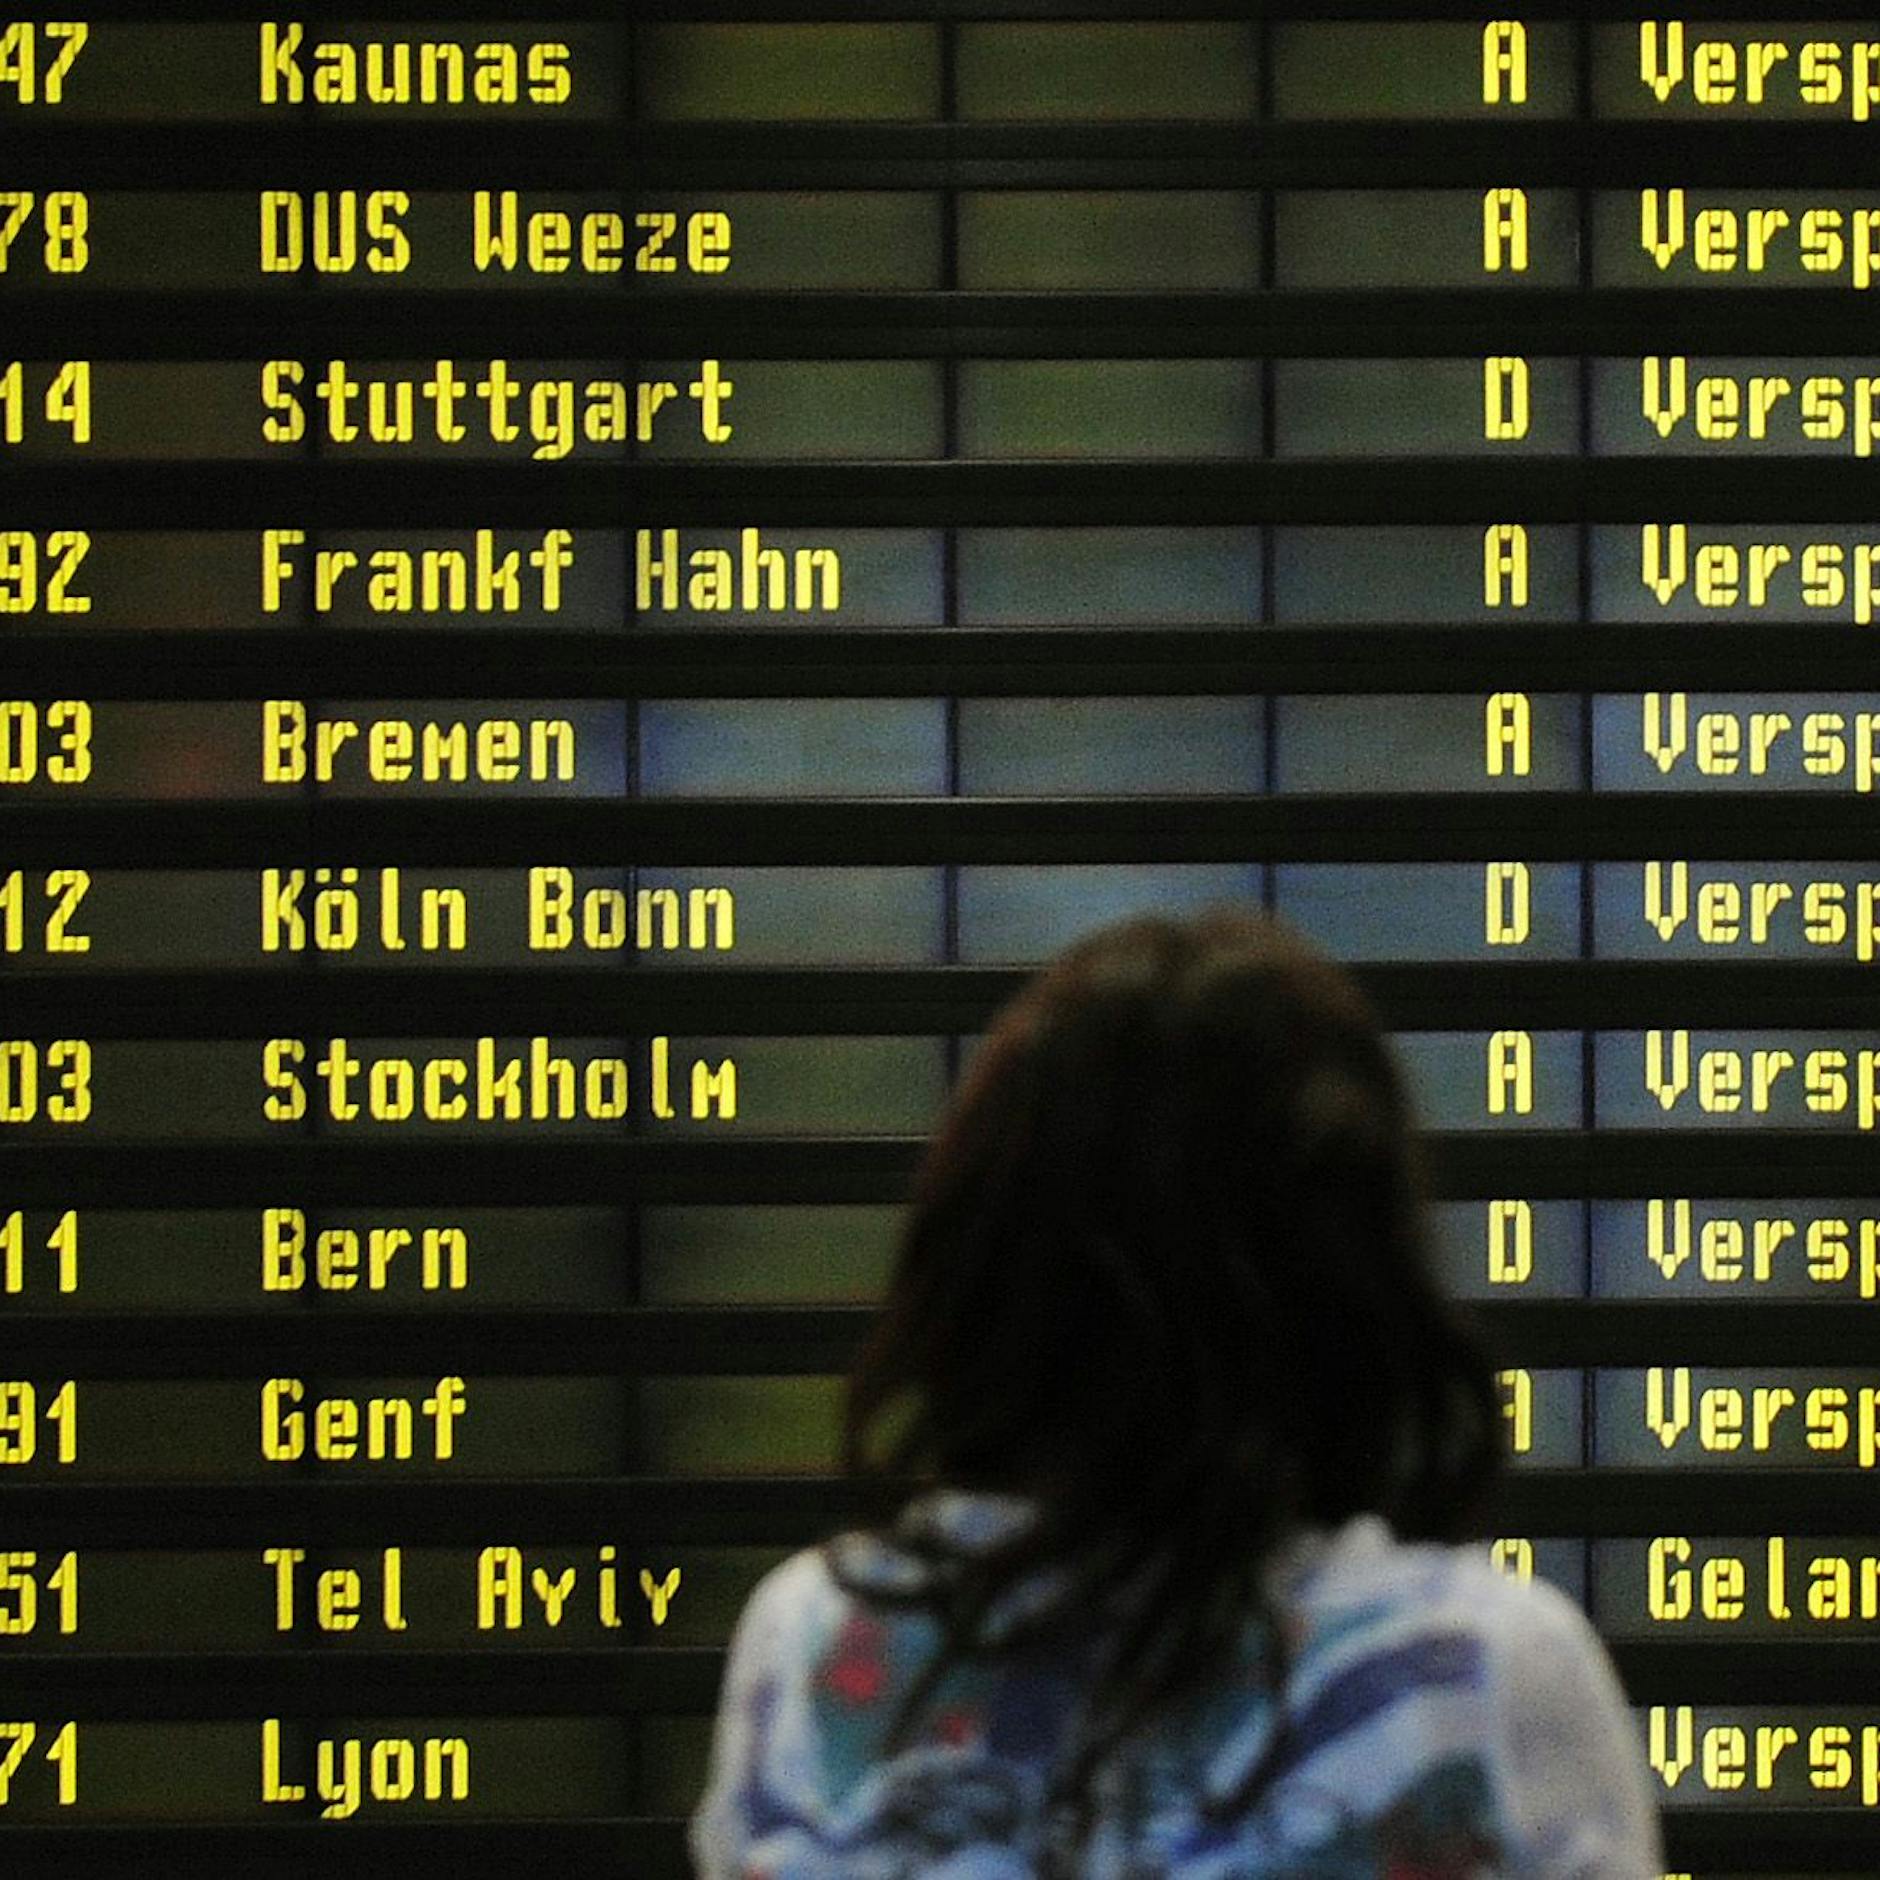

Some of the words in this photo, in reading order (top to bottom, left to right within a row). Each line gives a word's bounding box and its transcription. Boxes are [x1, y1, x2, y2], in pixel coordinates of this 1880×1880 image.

[262, 23, 570, 103] Kaunas
[1484, 20, 1527, 103] A
[1641, 21, 1880, 121] Versp
[262, 192, 410, 272] DUS
[475, 191, 730, 273] Weeze
[1485, 189, 1528, 271] A
[1642, 188, 1880, 289] Versp
[262, 360, 732, 460] Stuttgart
[1485, 357, 1528, 440] D
[1643, 356, 1880, 457] Versp
[263, 529, 573, 611] Frankf
[635, 528, 840, 611] Hahn
[1485, 524, 1528, 607] A
[1642, 524, 1880, 624] Versp
[263, 700, 574, 782] Bremen
[1487, 693, 1530, 776] A
[262, 868, 466, 951] Köln
[529, 866, 734, 950] Bonn
[1486, 863, 1529, 945] D
[264, 1036, 736, 1120] Stockholm
[1488, 1030, 1532, 1114] A
[263, 1208, 467, 1291] Bern
[1488, 1200, 1532, 1283] D
[262, 1376, 466, 1461] Genf
[264, 1548, 407, 1630] Tel
[479, 1546, 681, 1628] Aviv
[263, 1719, 468, 1819] Lyon
